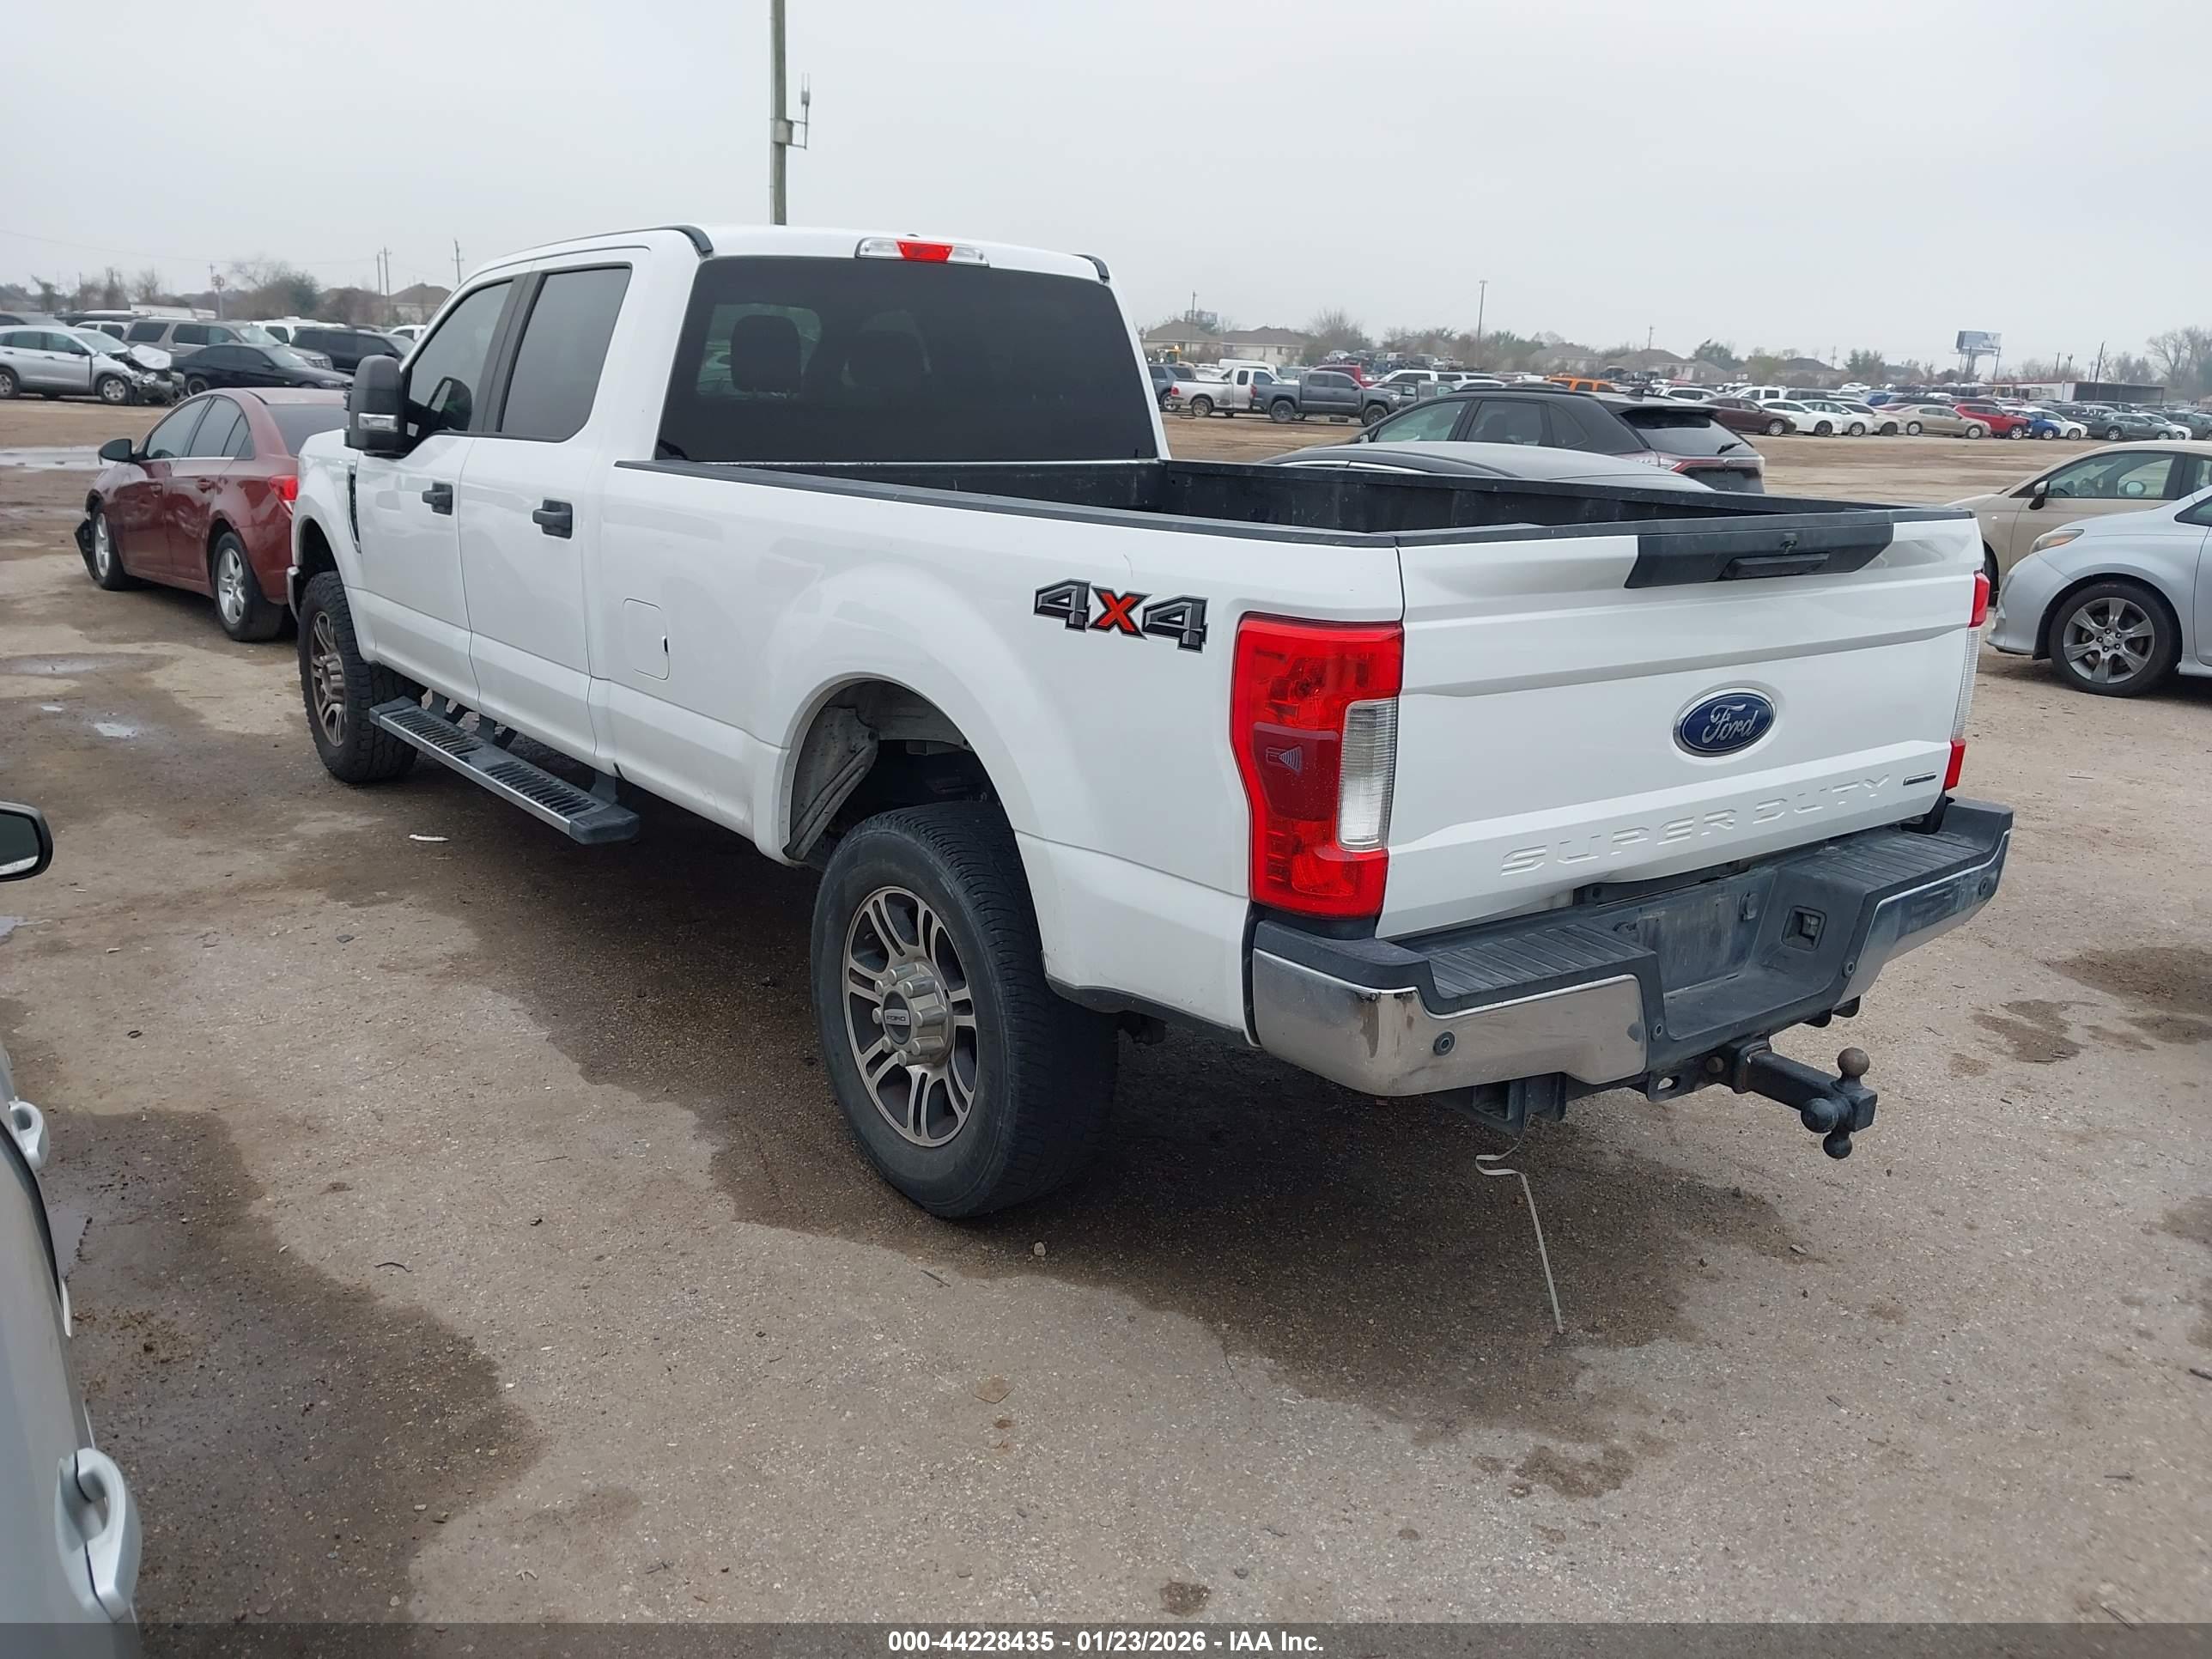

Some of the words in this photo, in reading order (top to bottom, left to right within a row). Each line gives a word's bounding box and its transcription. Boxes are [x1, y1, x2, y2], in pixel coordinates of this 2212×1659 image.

[1702, 704, 1759, 744] Ford
[1500, 807, 1737, 876] SUPER
[1753, 774, 1890, 824] DUTY
